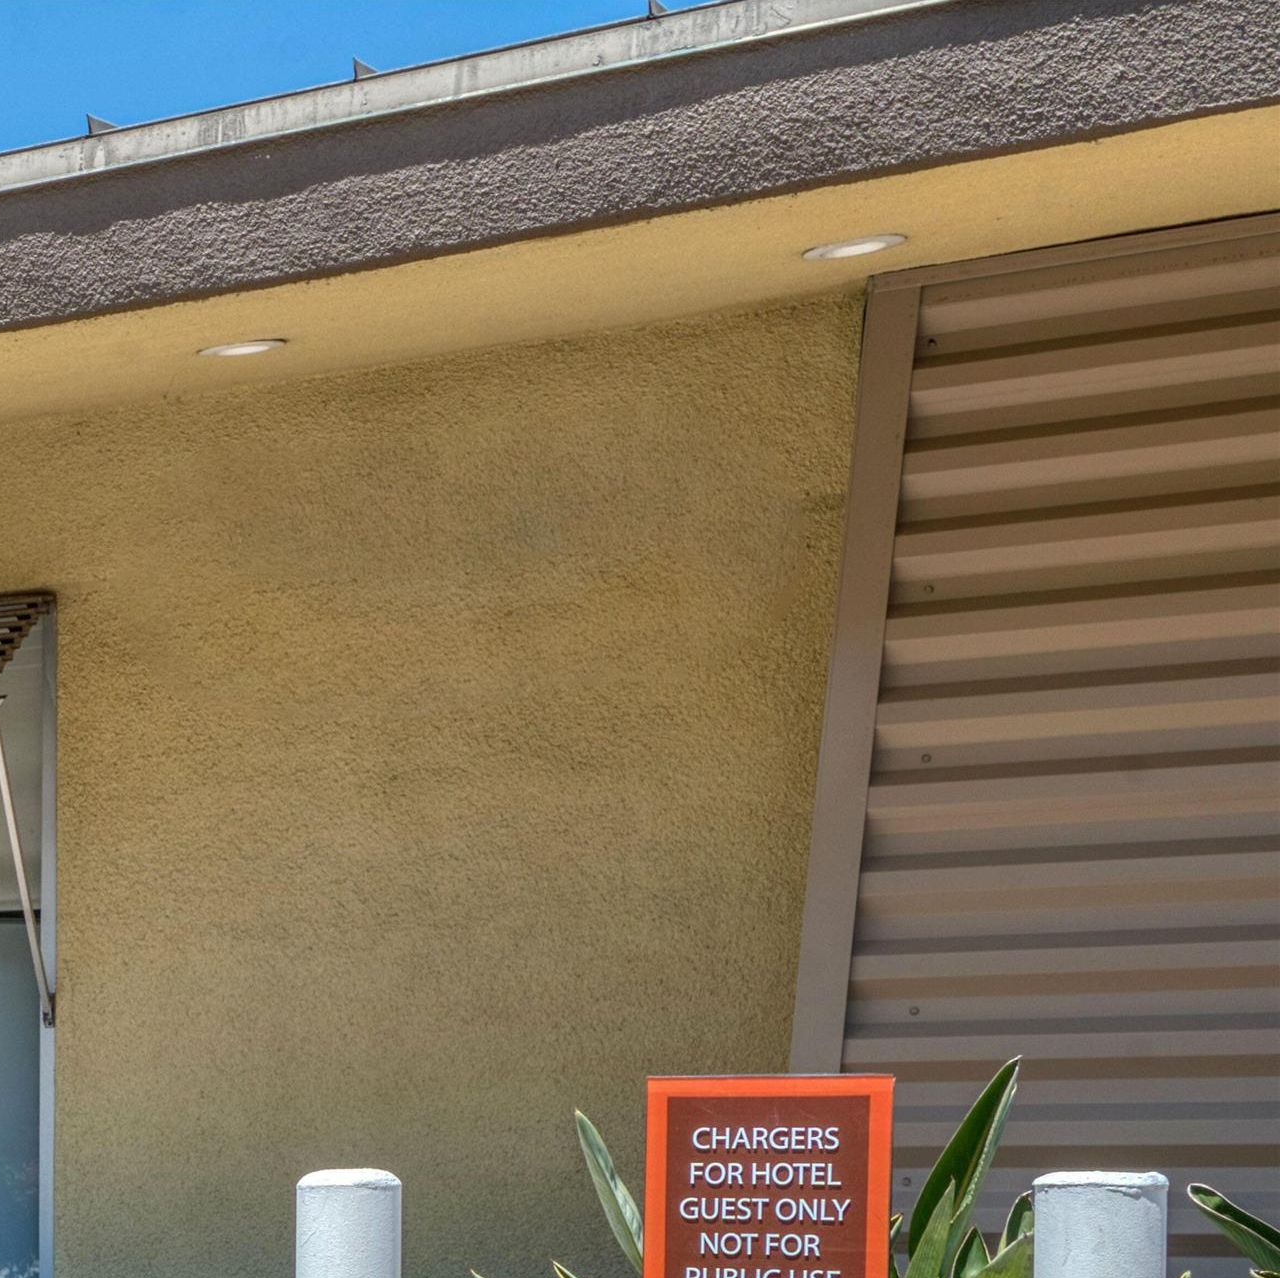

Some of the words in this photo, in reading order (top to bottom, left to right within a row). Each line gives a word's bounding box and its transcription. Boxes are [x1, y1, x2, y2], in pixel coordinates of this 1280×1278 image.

[692, 1126, 840, 1150] CHARGERS
[689, 1161, 744, 1186] FOR
[751, 1162, 842, 1186] HOTEL
[679, 1196, 770, 1221] GUEST
[774, 1197, 851, 1222] ONLY
[699, 1232, 759, 1256] NOT
[764, 1233, 821, 1257] FOR
